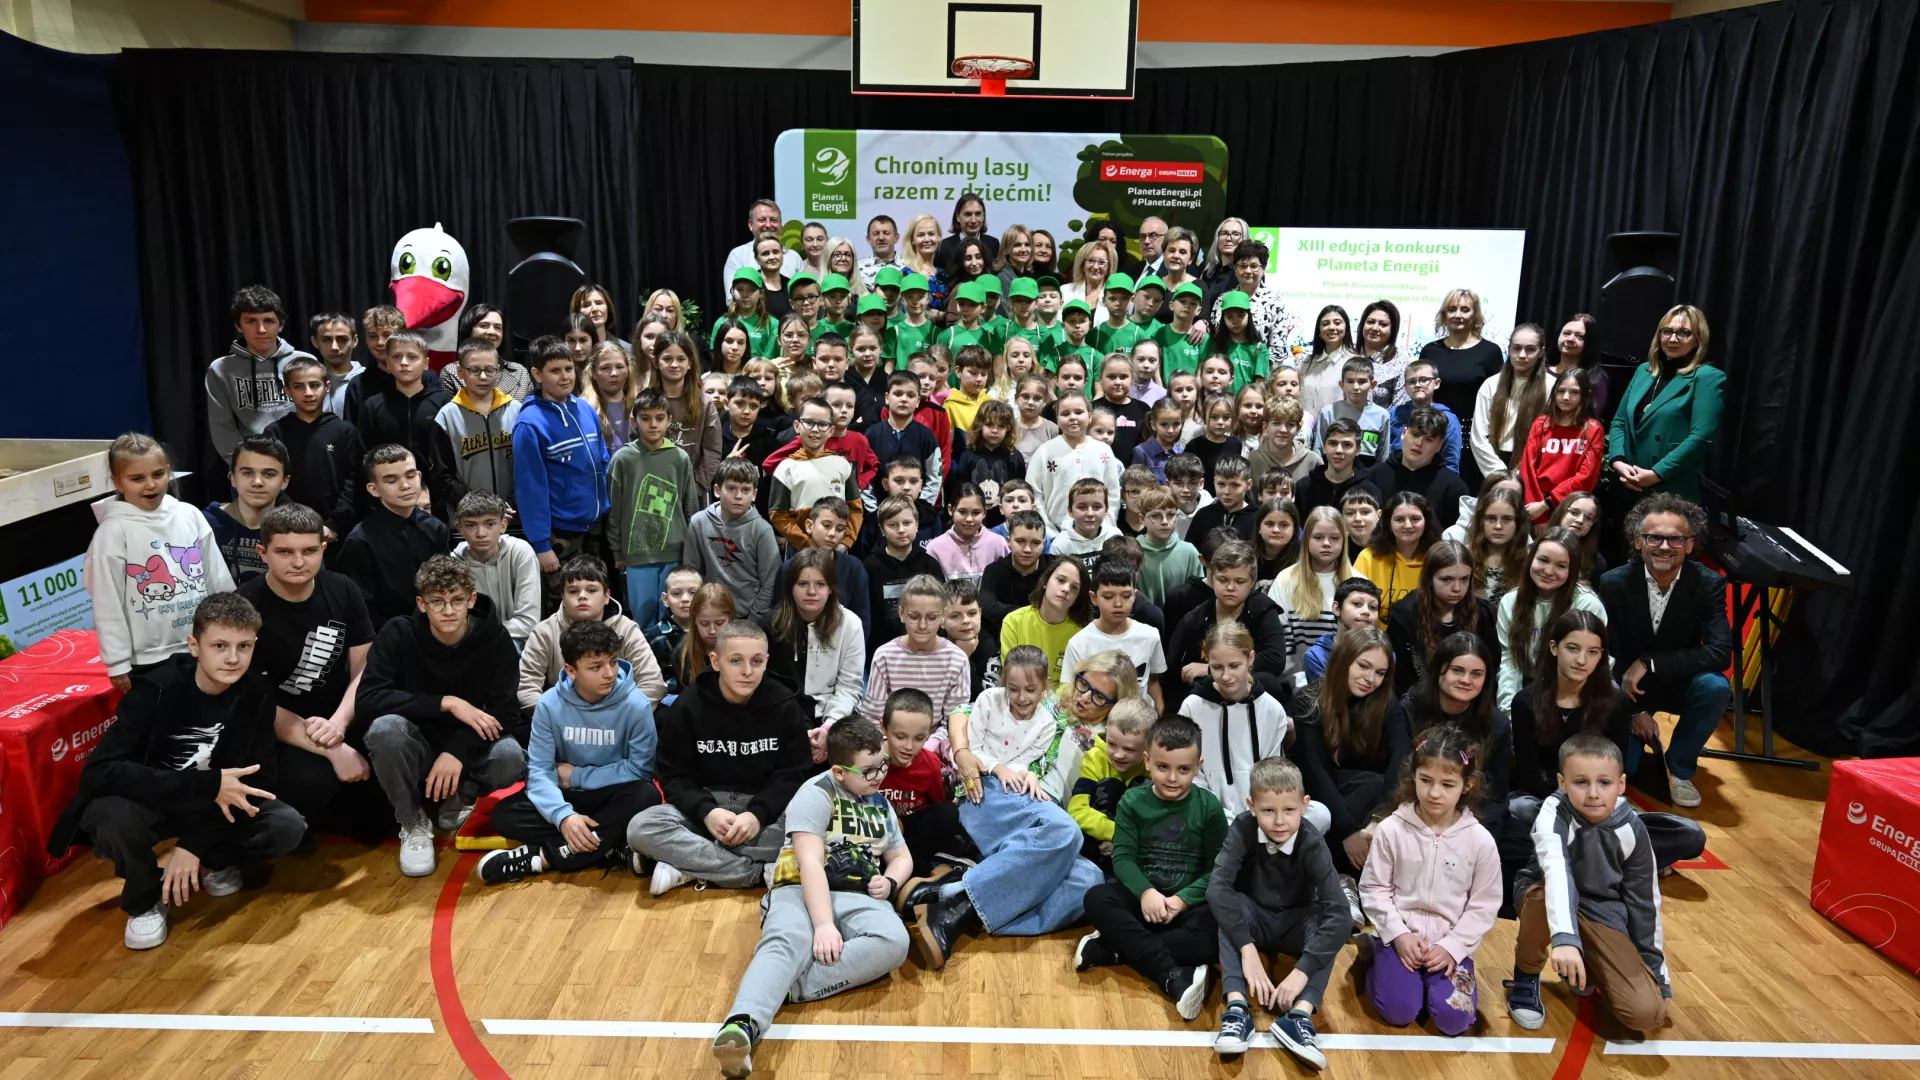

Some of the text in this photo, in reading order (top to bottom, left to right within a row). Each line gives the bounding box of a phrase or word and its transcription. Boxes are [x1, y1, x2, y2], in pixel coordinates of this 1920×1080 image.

[874, 156, 1030, 181] Chronimy lasy
[1119, 166, 1153, 178] Energa
[812, 193, 844, 201] Planeta
[873, 182, 1052, 202] razem z dziećmi!
[1127, 187, 1203, 198] PlanetaEnergii.pl
[812, 202, 849, 214] Energii
[1132, 198, 1201, 209] #PlanetaEnergii
[1298, 239, 1460, 255] XIII edycja konkursu
[1317, 258, 1440, 276] Planeta Energii
[234, 376, 295, 410] EVERLA
[17, 581, 43, 607] 11
[44, 568, 77, 596] 000
[177, 594, 206, 611] MELO
[172, 614, 194, 629] KUR
[563, 725, 616, 746] PUMA
[74, 745, 97, 762] GRU
[696, 737, 779, 757] STAY TRUE
[1869, 837, 1898, 858] GRUPA
[813, 979, 851, 999] TENNIS
